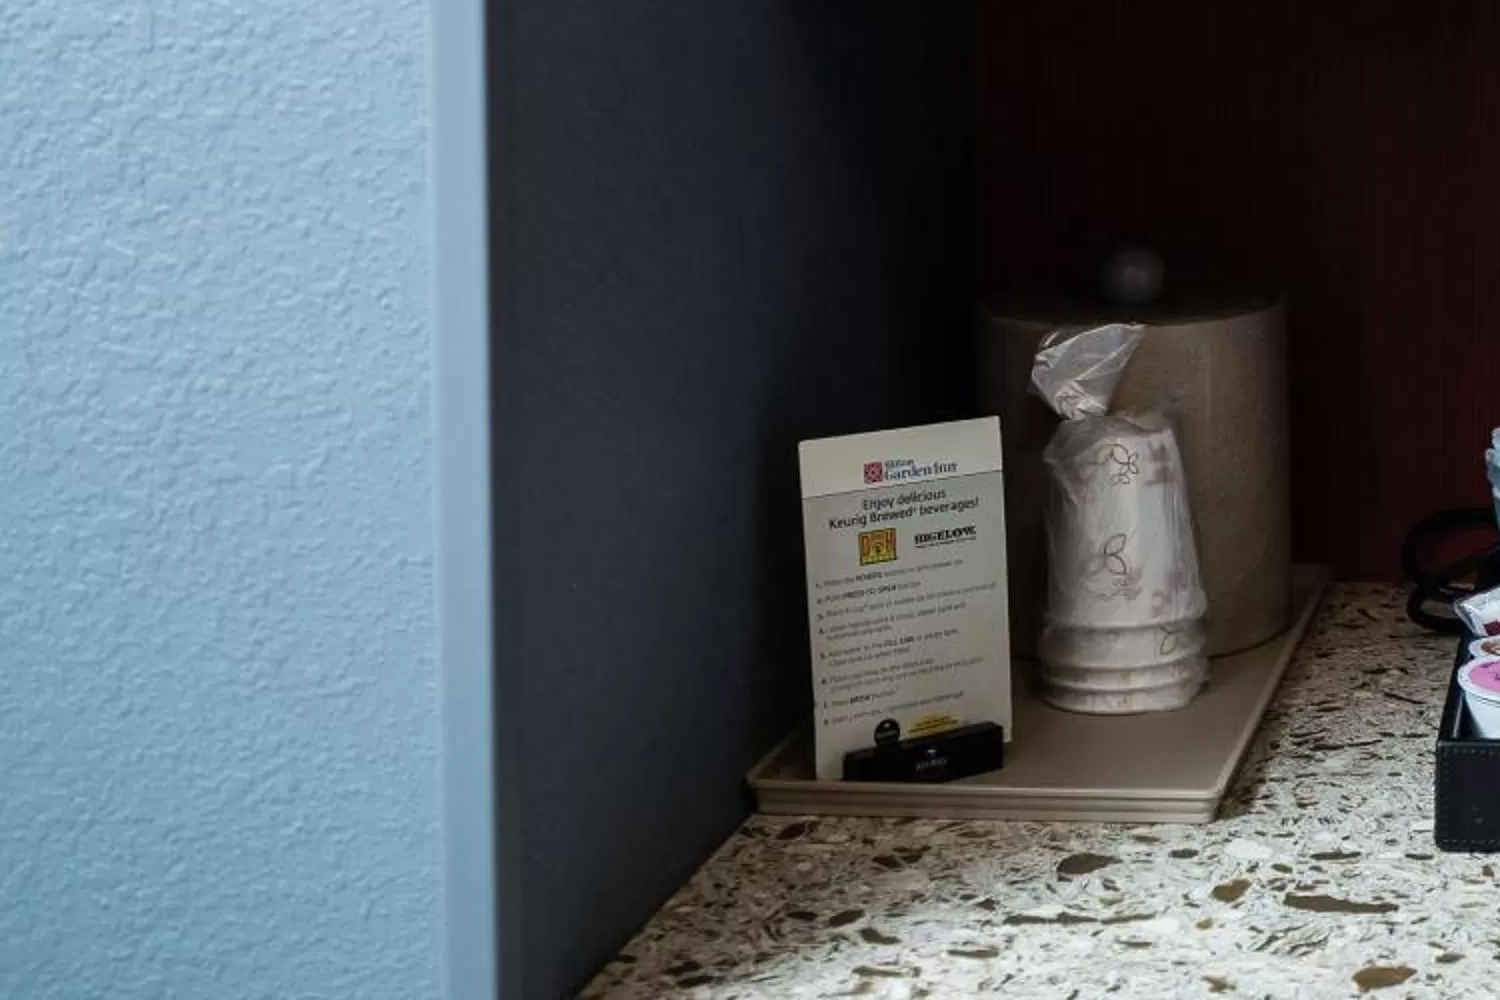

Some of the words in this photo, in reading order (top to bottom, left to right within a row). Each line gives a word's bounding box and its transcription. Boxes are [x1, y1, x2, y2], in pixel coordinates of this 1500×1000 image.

[829, 512, 867, 529] Keurig
[919, 496, 979, 516] beverages!
[863, 495, 895, 511] Enjoy
[896, 488, 946, 504] delicious
